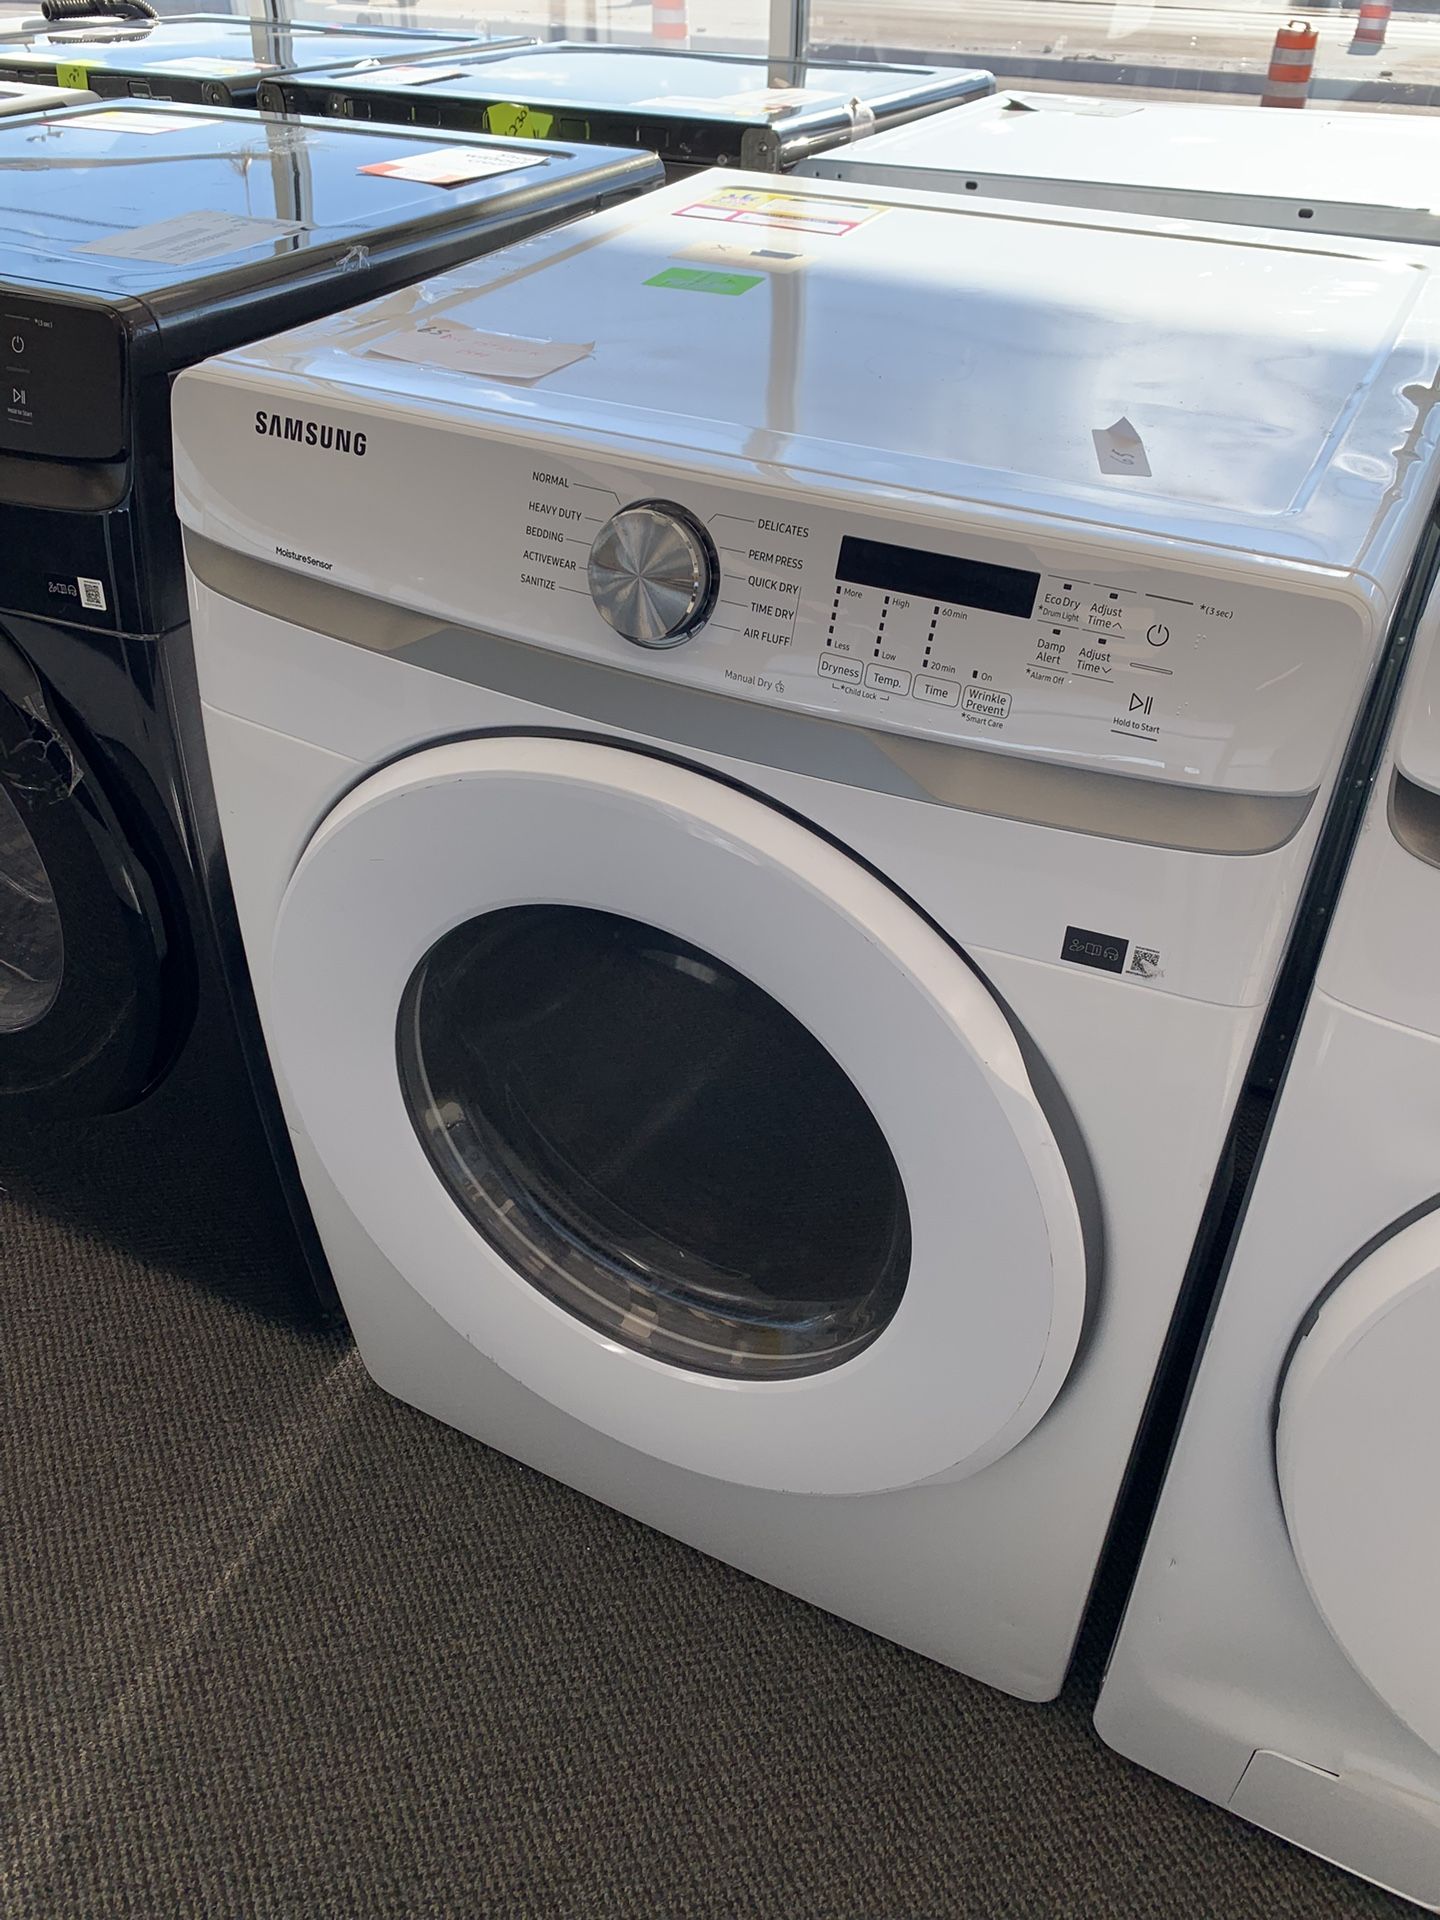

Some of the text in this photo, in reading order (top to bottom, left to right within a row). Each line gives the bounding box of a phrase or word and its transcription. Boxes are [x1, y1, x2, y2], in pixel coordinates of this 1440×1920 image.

[255, 411, 367, 456] SAMSUNG
[532, 471, 569, 488] NORMAL
[528, 501, 582, 521] HEAVY DUTY
[525, 525, 564, 543] BEDDING
[757, 518, 809, 538] DELICATES
[522, 550, 576, 570] ACTIVEWEAR
[748, 549, 803, 570] PERM PRESS
[520, 573, 556, 591] SANITIZE
[748, 575, 799, 595] QUICK DRY
[843, 587, 863, 599] More
[751, 602, 795, 620] TIME DRY
[892, 598, 910, 610] High
[1089, 603, 1123, 618] Adjust
[743, 627, 791, 646] AIR FLUFF
[834, 640, 850, 651] Less
[1037, 638, 1066, 653] Damp
[881, 651, 897, 661] Low
[1036, 651, 1061, 665] Alert
[1078, 647, 1111, 662] Adjust
[821, 660, 859, 678] Dryness
[980, 672, 993, 682] On
[724, 669, 773, 691] Manual Dry
[873, 672, 901, 688] Temp.
[1052, 675, 1065, 685] Off
[861, 689, 877, 700] Lock
[924, 684, 948, 698] Time
[969, 688, 1007, 706] Wrinkle
[965, 699, 1004, 716] Prevent
[987, 718, 1004, 729] Care
[1113, 717, 1160, 734] Hold to Start
